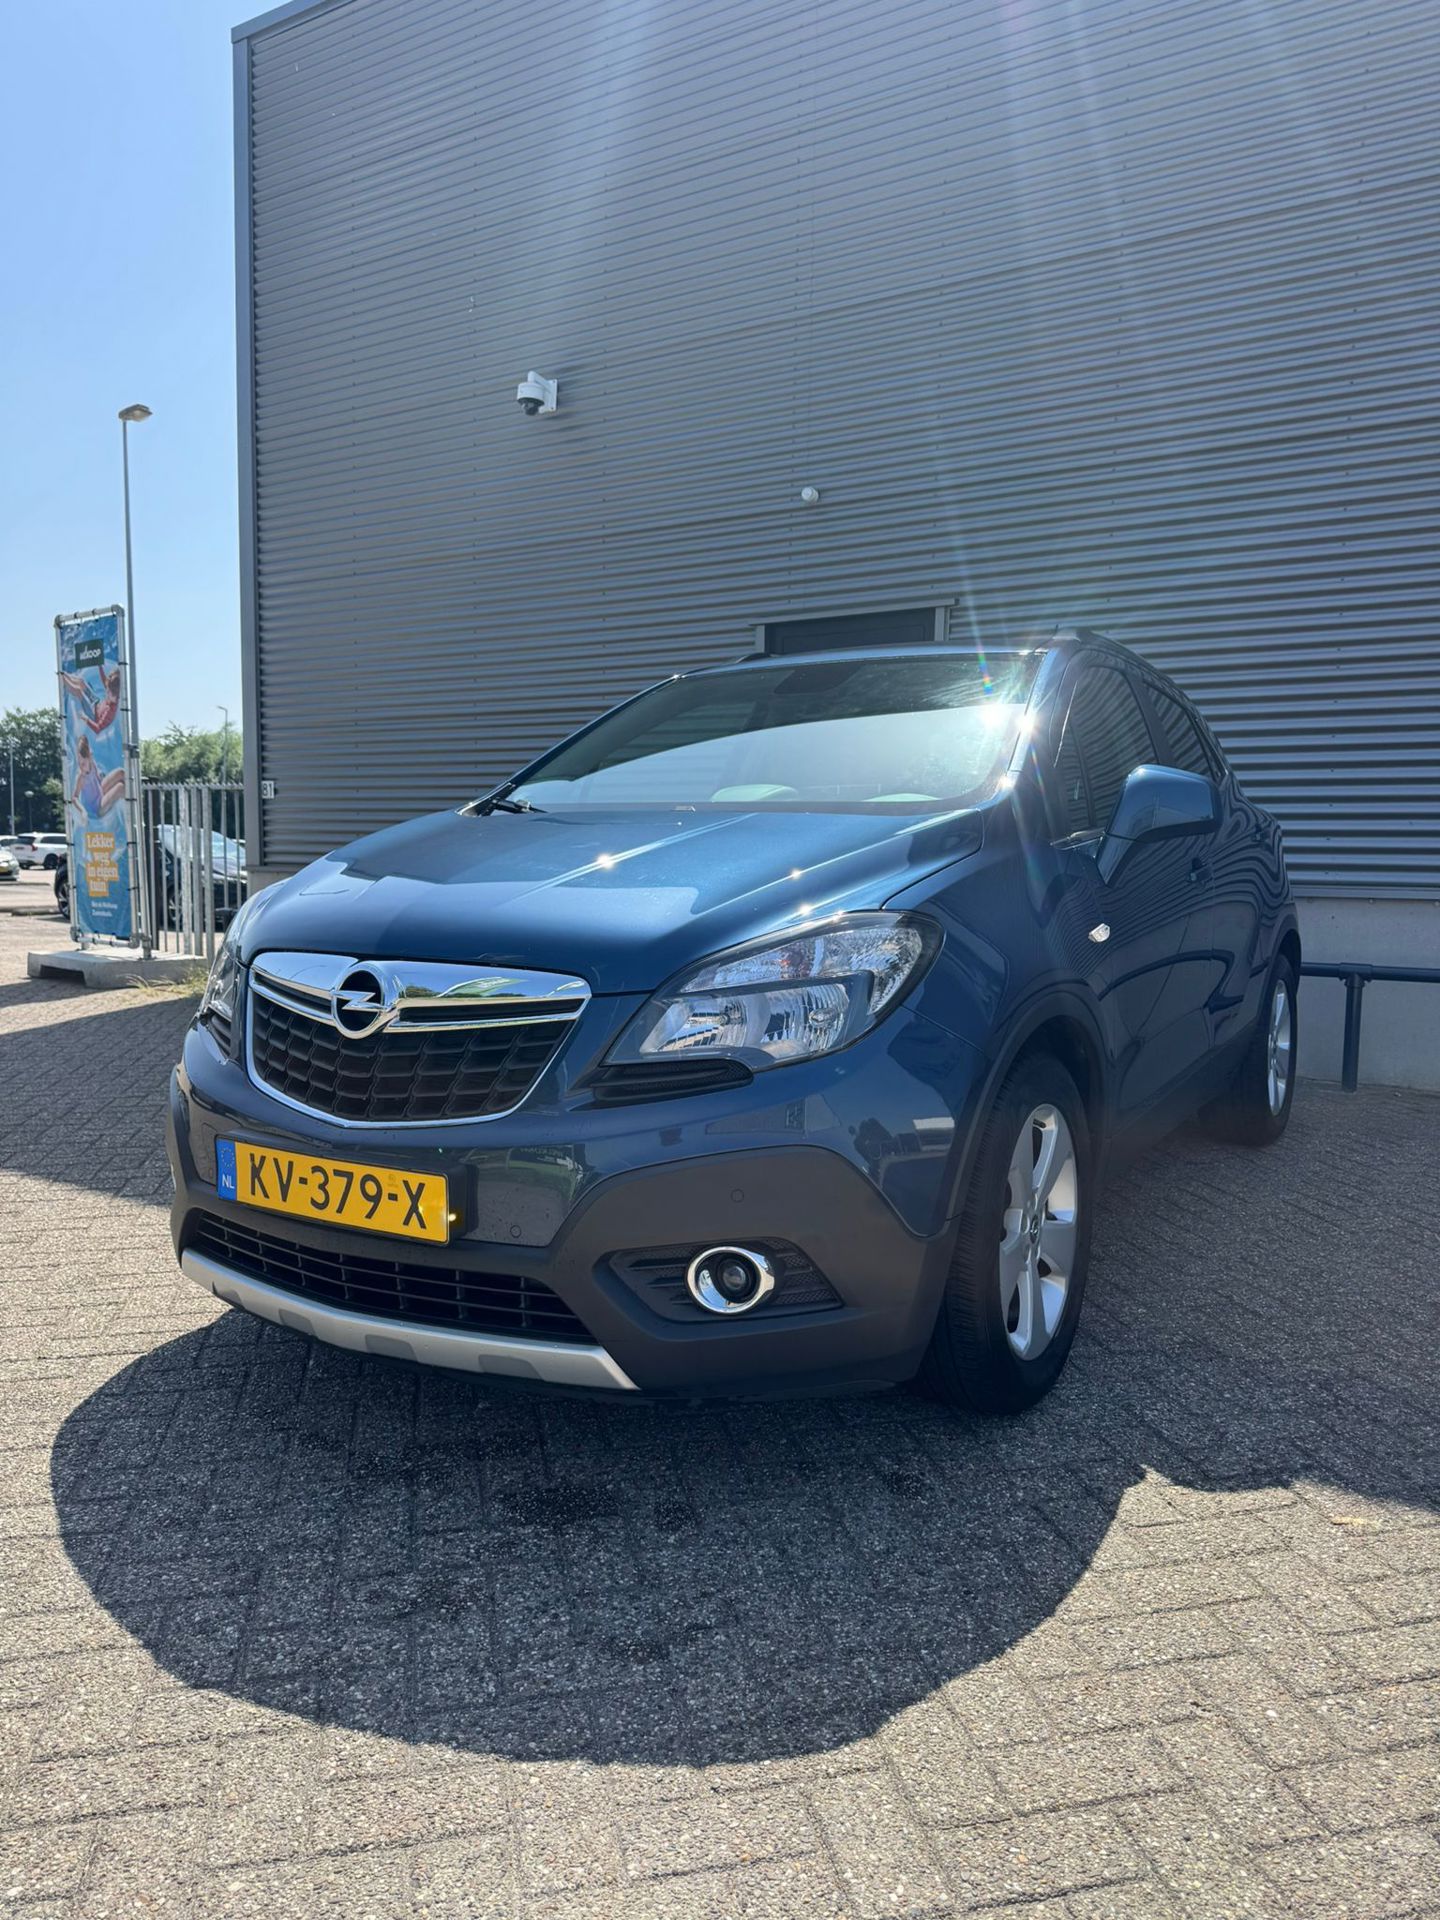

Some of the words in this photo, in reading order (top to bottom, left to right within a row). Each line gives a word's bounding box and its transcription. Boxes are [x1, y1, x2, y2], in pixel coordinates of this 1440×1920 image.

[87, 833, 114, 849] Lekker
[221, 1174, 235, 1189] NL
[249, 1152, 427, 1230] KV-379-X
